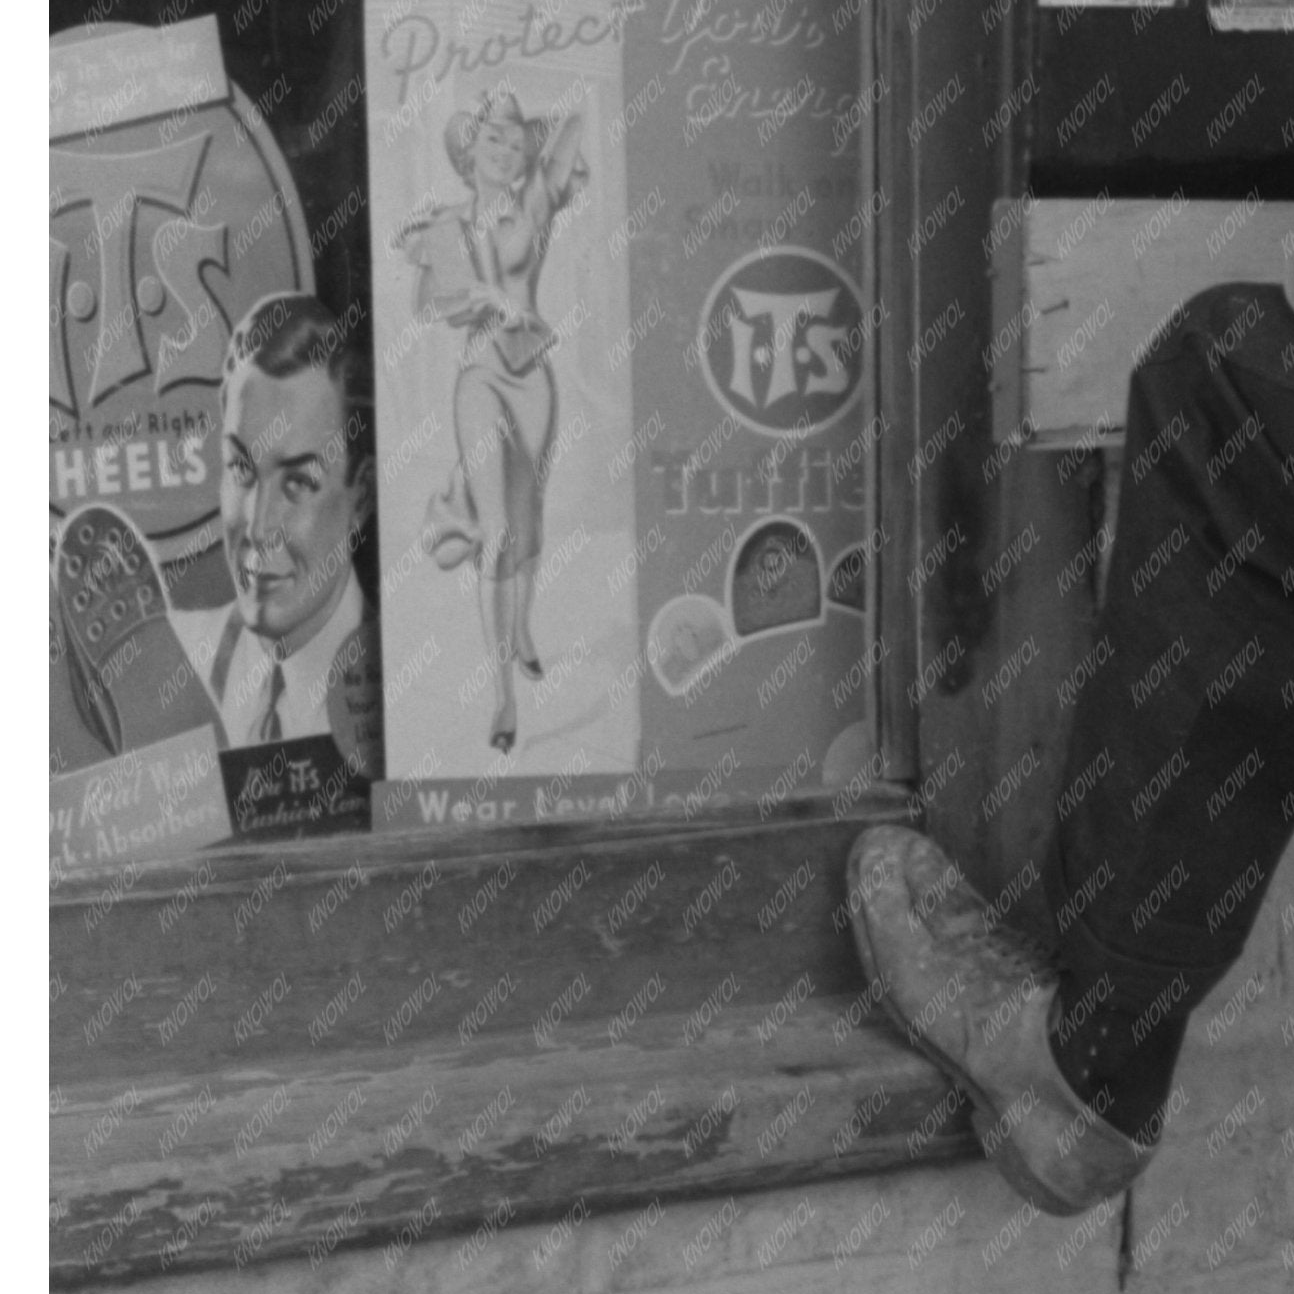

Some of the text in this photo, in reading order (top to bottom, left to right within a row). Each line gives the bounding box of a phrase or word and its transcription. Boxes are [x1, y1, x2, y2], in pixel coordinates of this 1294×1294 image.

[102, 410, 142, 437] and
[147, 411, 209, 439] Right
[54, 435, 209, 500] HEELS
[79, 774, 143, 829] Real
[417, 789, 517, 825] Wear
[534, 780, 631, 819] Level
